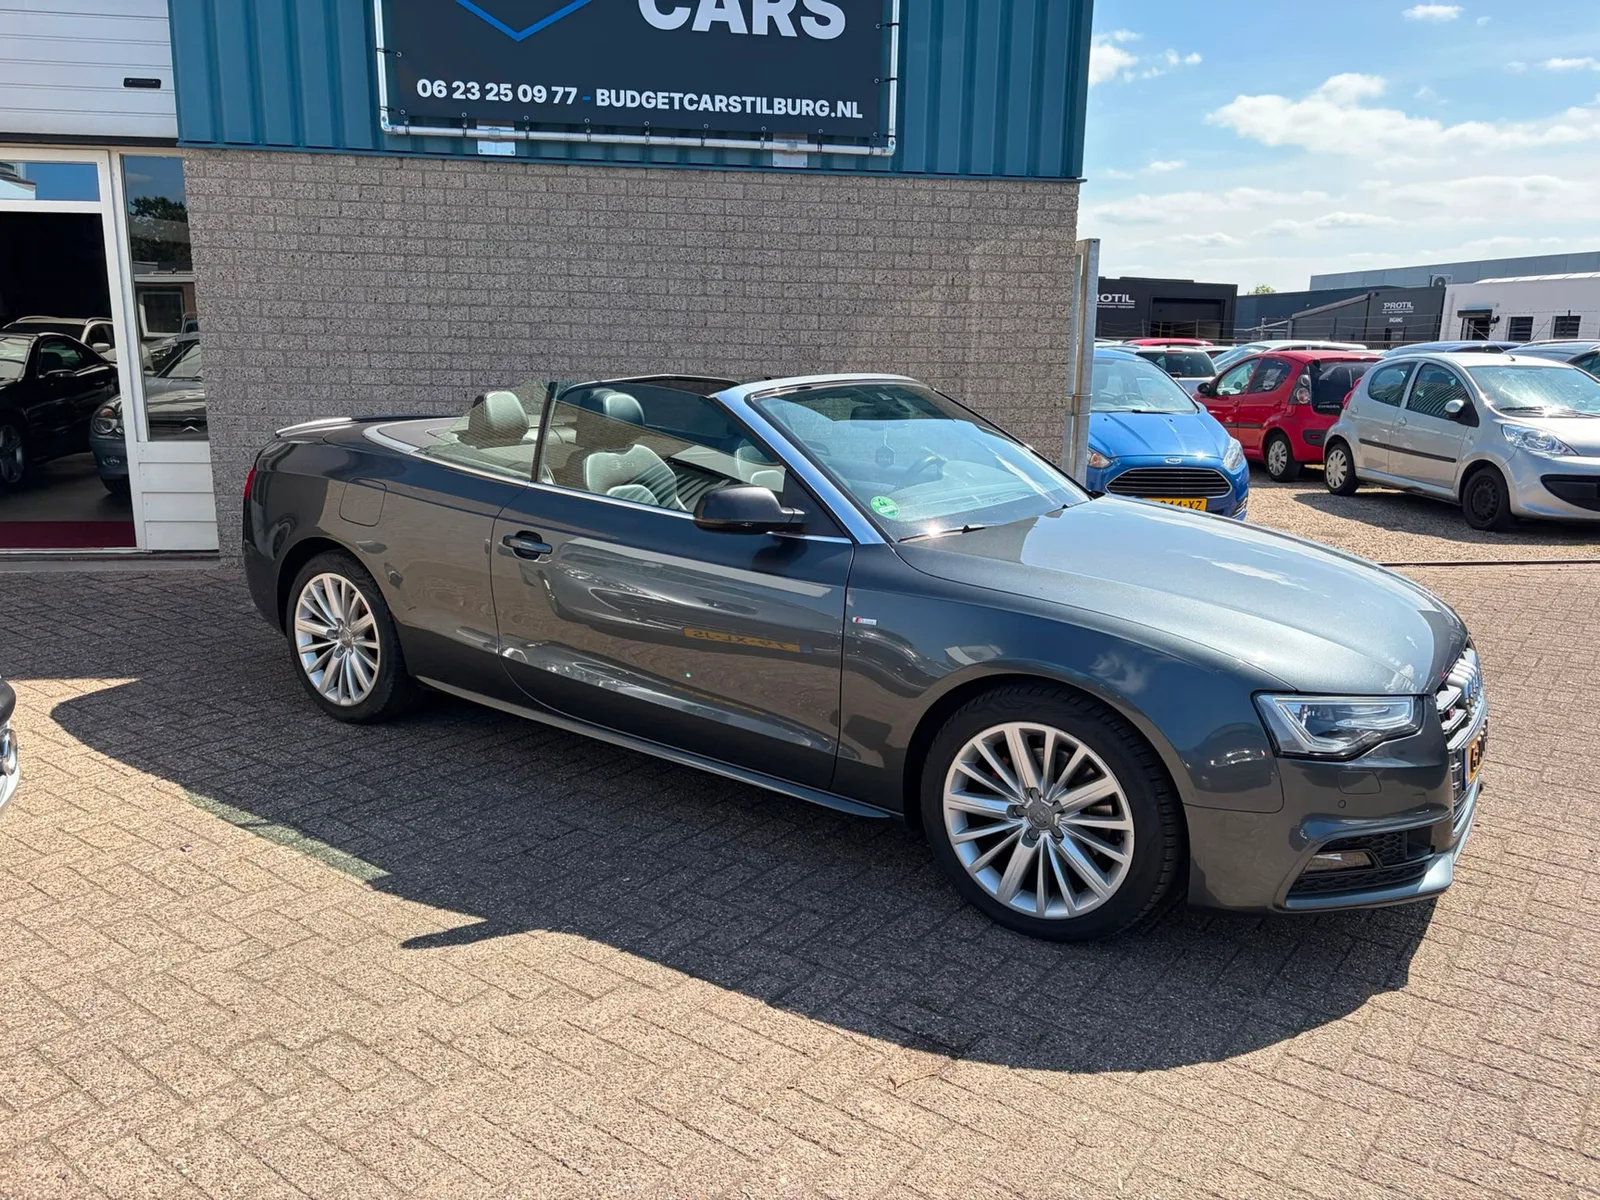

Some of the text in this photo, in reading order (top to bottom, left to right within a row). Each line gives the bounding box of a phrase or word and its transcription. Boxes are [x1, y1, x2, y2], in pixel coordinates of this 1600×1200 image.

[638, 0, 846, 40] CARS
[416, 78, 447, 98] 06
[451, 80, 481, 101] 23
[485, 82, 513, 102] 25
[517, 84, 547, 104] 09
[551, 86, 578, 105] 77
[595, 88, 863, 119] BUDGETCARSTILBURG.NL
[1097, 293, 1135, 303] OTIL
